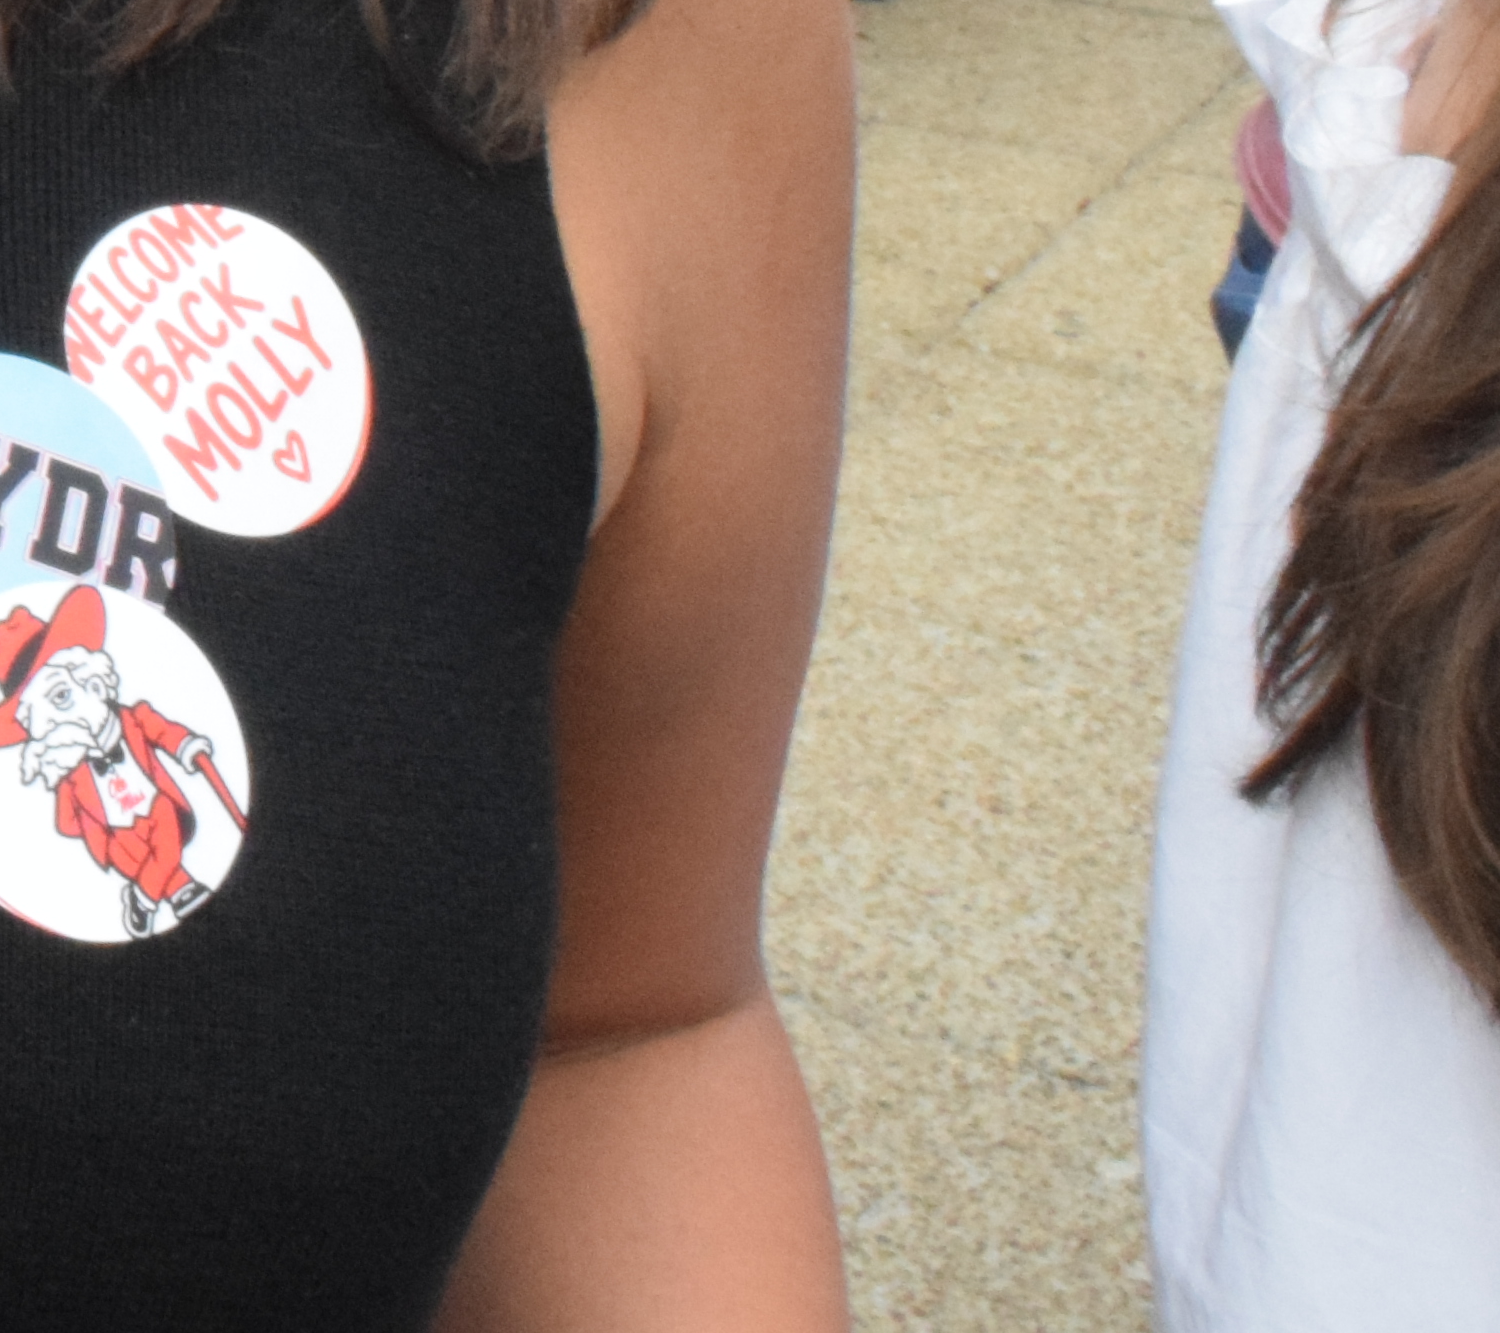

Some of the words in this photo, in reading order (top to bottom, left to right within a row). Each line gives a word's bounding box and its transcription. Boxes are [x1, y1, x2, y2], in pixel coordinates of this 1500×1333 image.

[65, 203, 245, 385] WELCOME
[122, 262, 265, 413] BACK
[162, 295, 333, 503] MOLLY
